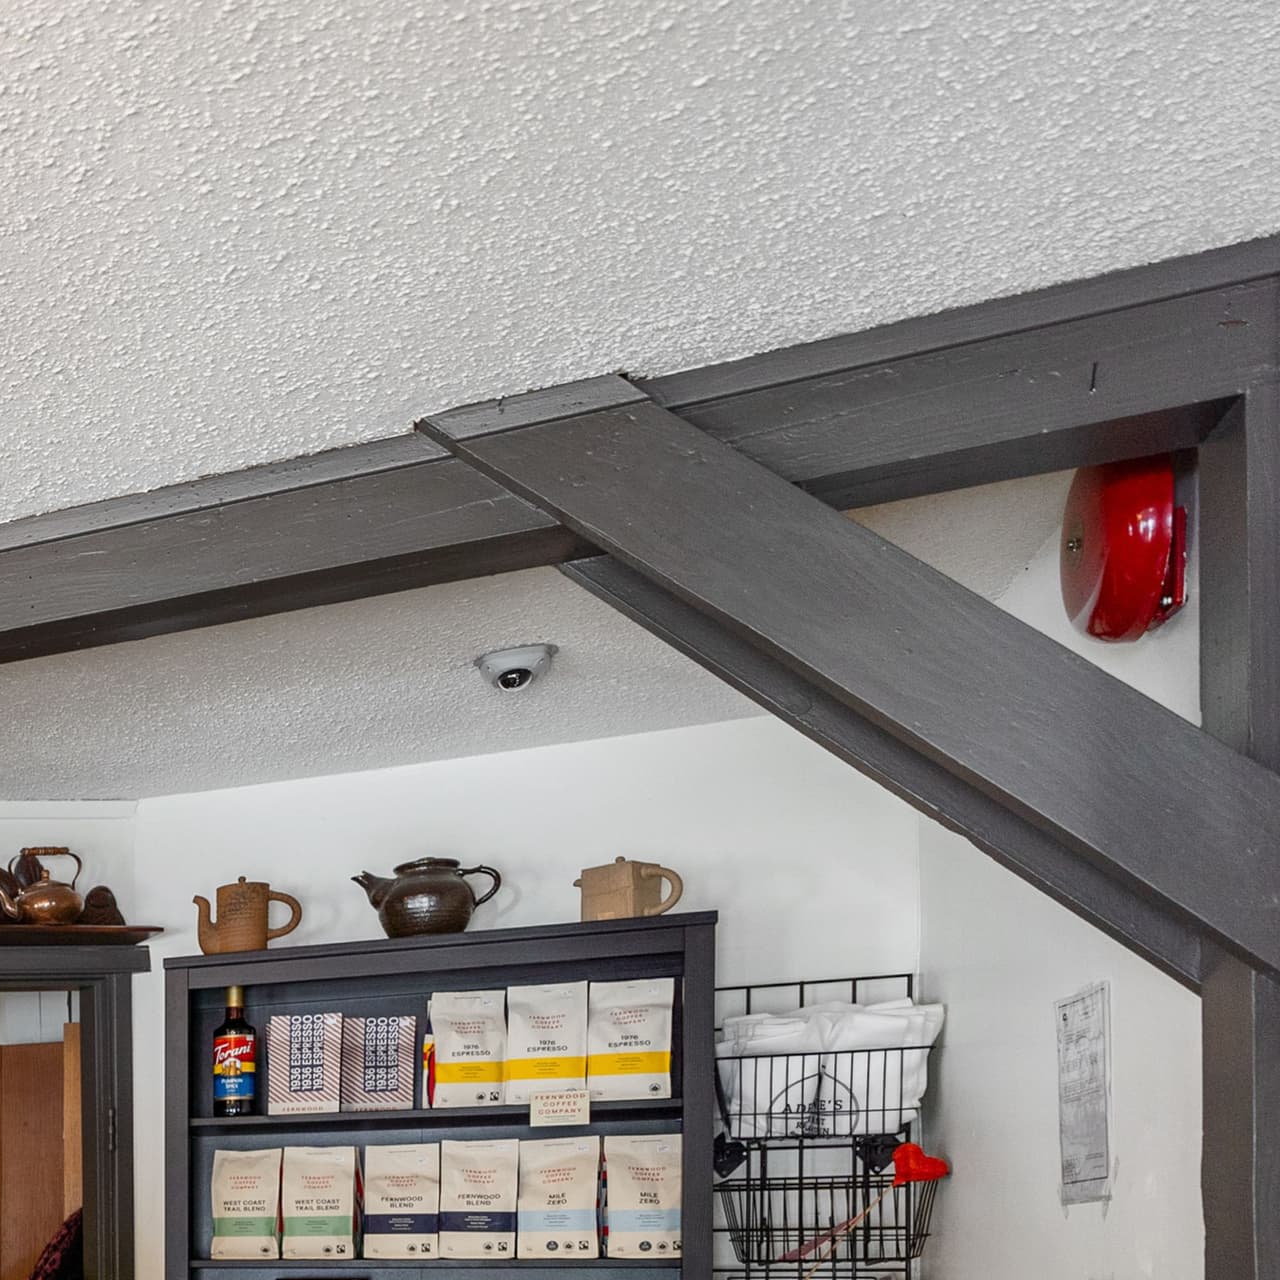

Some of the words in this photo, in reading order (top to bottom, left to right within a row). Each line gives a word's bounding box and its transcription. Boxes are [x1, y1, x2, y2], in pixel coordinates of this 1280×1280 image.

[291, 1016, 301, 1066] ESPRESSO
[313, 1014, 324, 1065] ESPRESSO
[365, 1017, 376, 1066] ESPRESSO
[387, 1016, 398, 1066] ESPRESSO
[608, 1040, 651, 1048] ESPRESSO
[214, 1042, 252, 1064] Torani
[291, 1067, 301, 1091] 1936
[313, 1066, 324, 1090] 1936
[365, 1067, 376, 1091] 1936
[387, 1067, 398, 1090] 1936
